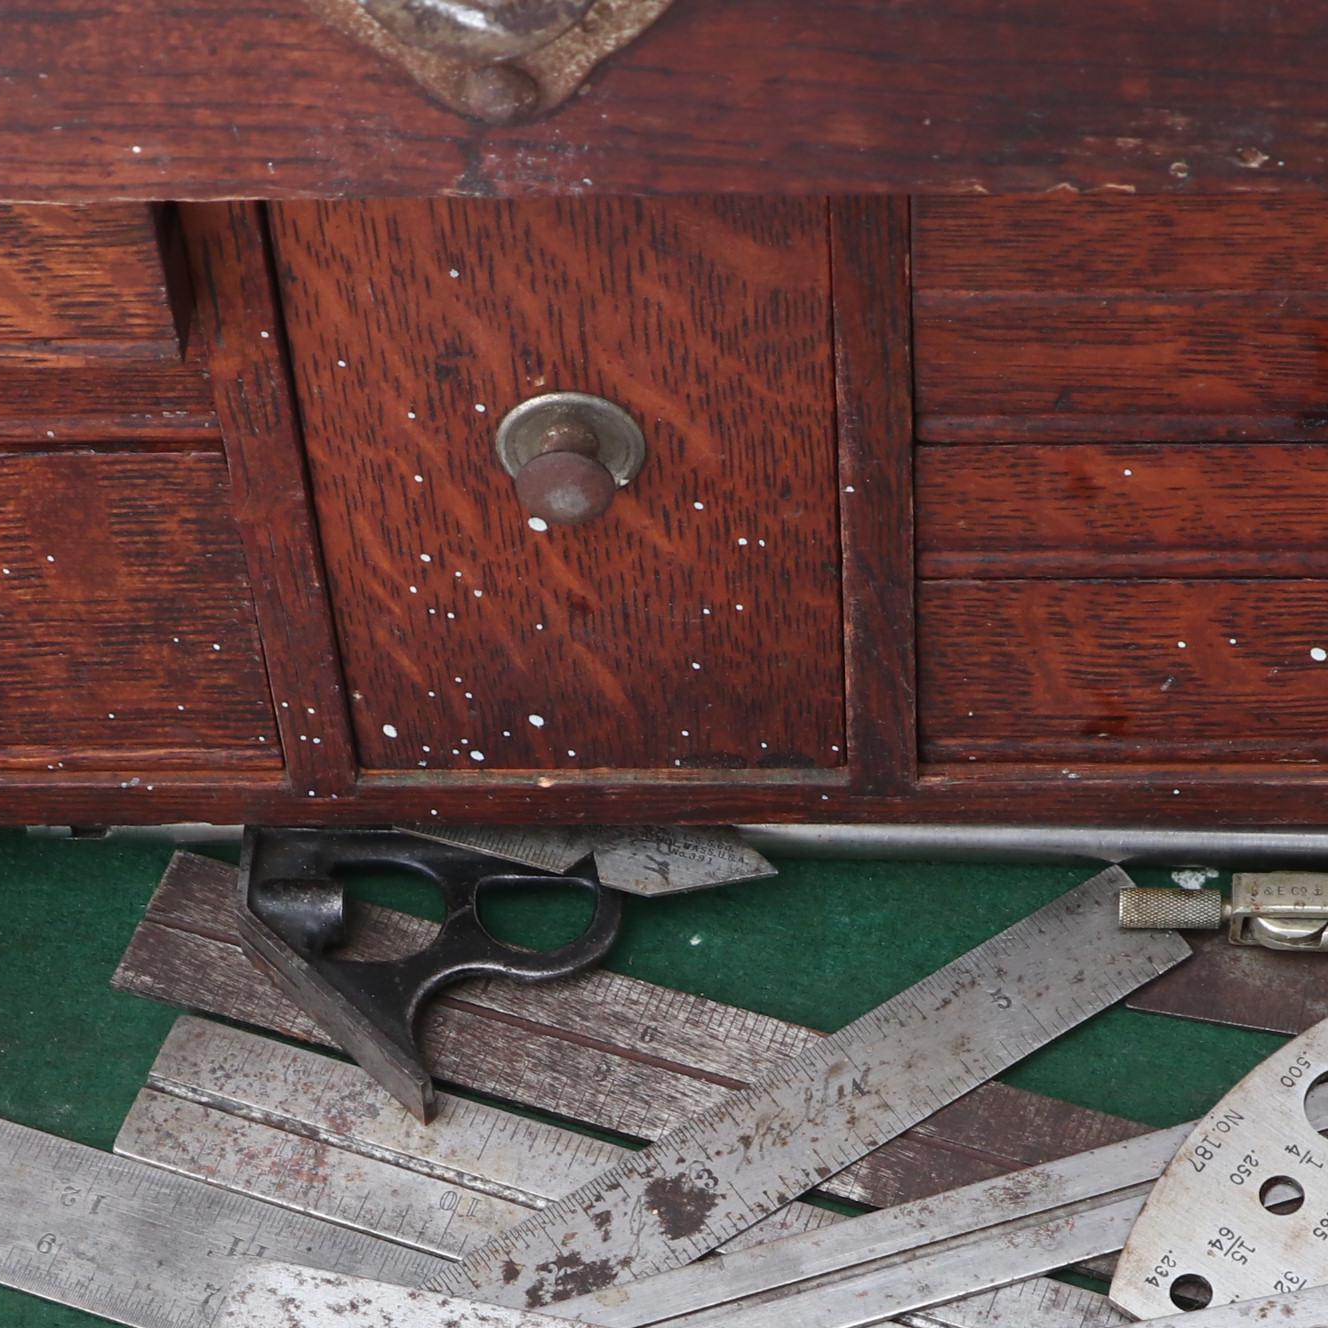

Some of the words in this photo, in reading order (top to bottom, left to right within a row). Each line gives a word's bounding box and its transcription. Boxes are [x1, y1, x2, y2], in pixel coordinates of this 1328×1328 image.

[1280, 1051, 1312, 1088] .500
[1229, 1149, 1259, 1185] .250
[1145, 1250, 1177, 1288] .234
